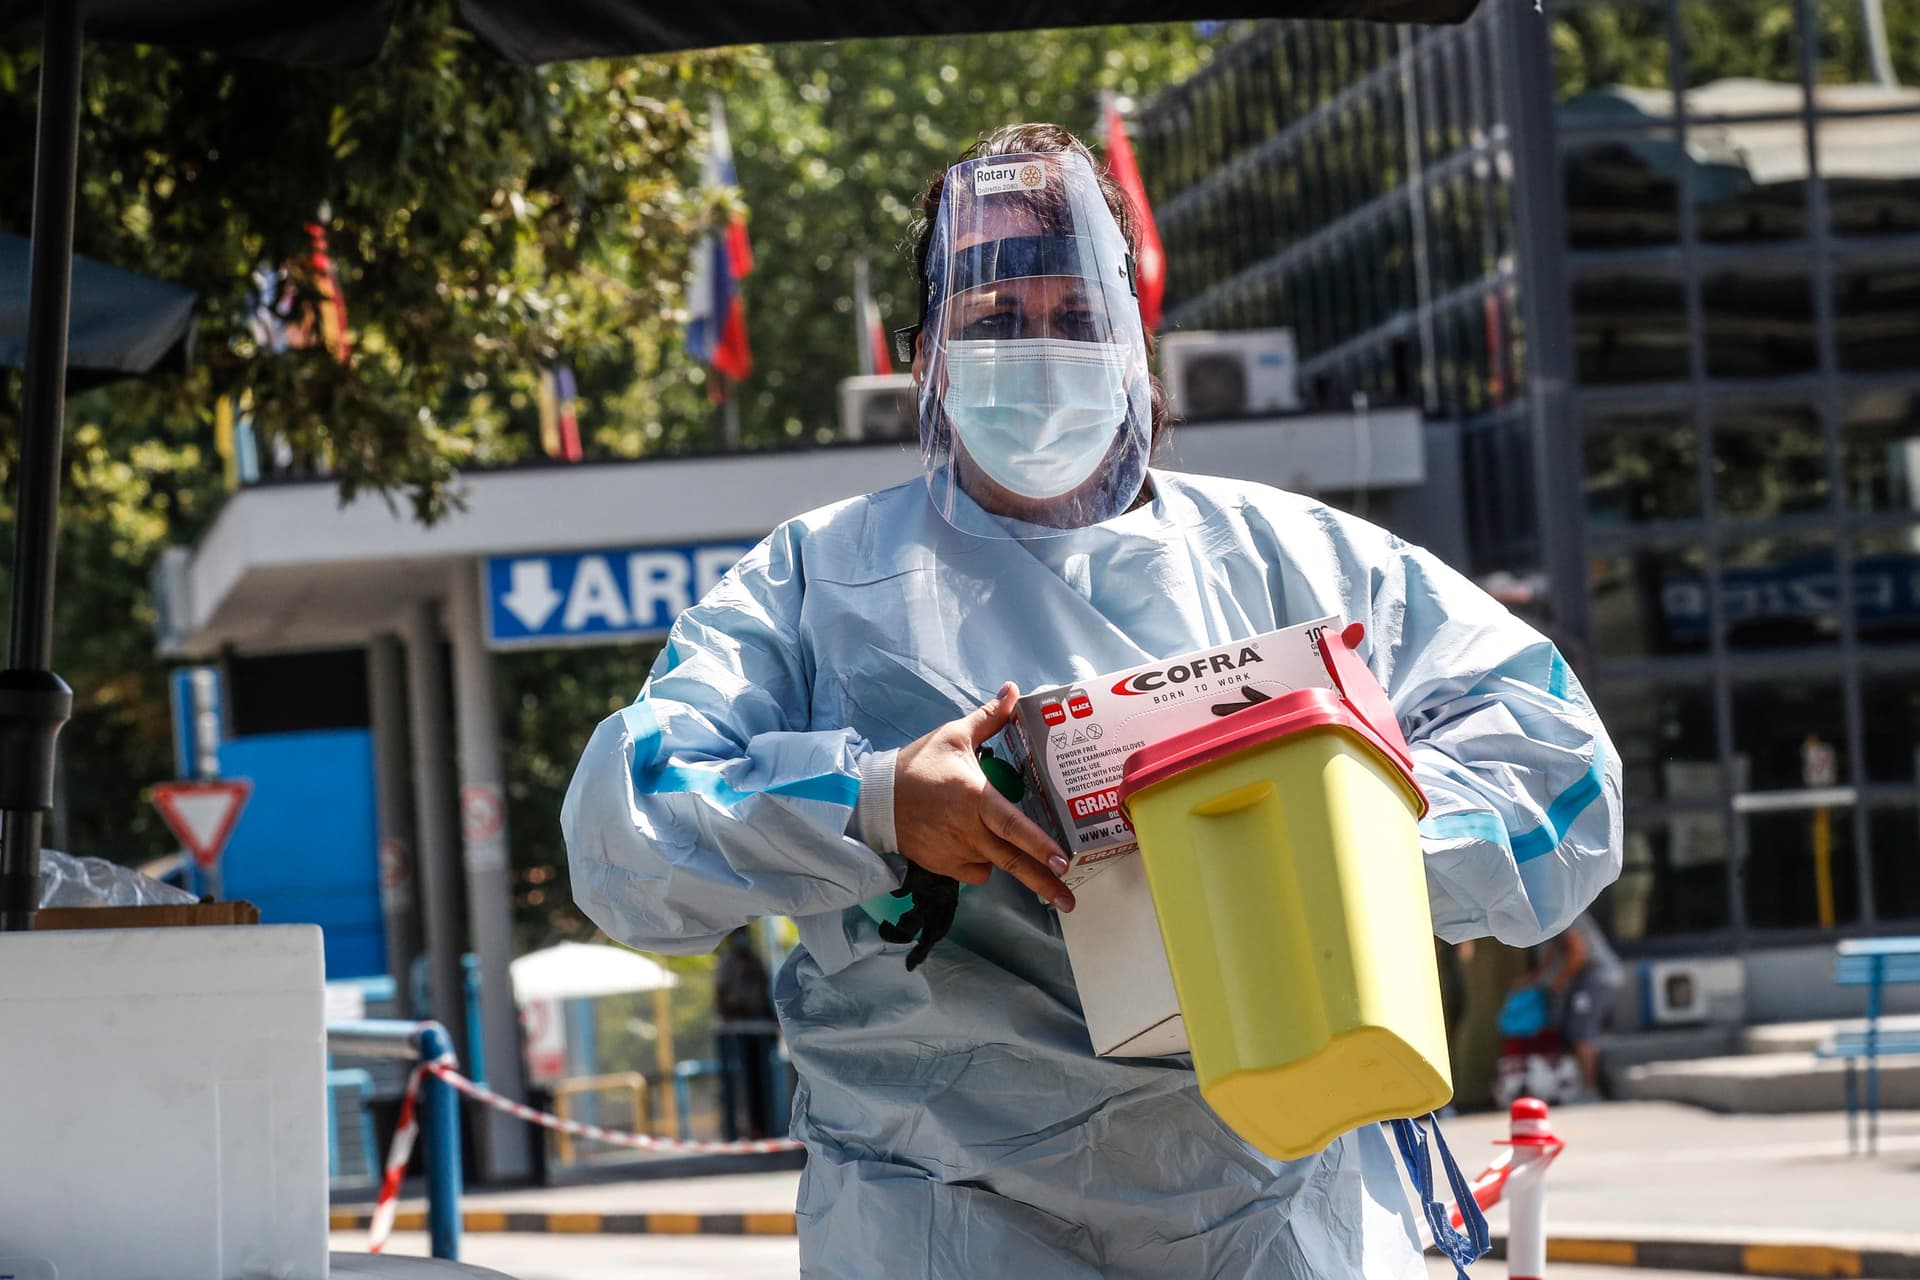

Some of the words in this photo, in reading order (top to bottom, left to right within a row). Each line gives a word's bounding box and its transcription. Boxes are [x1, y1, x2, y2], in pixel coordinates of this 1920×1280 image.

[976, 169, 1016, 182] Rotary
[1305, 625, 1328, 643] 10
[1132, 646, 1264, 691] COFRA
[1153, 689, 1185, 704] BORN
[1194, 684, 1208, 694] TO
[1218, 672, 1251, 687] WORK
[1071, 702, 1091, 712] BLACK
[1056, 748, 1082, 761] POWDER
[1082, 744, 1098, 754] FREE
[1059, 758, 1082, 769] NITRILE
[1083, 747, 1122, 763] EXAMINATION
[1122, 740, 1146, 752] GLOVES
[1062, 765, 1089, 777] MEDICAL
[1089, 761, 1101, 770] USE
[1064, 773, 1091, 785] CONTACT
[1093, 768, 1108, 778] WITH
[1067, 779, 1104, 794] PROTECTION
[1074, 790, 1119, 816] GRAB
